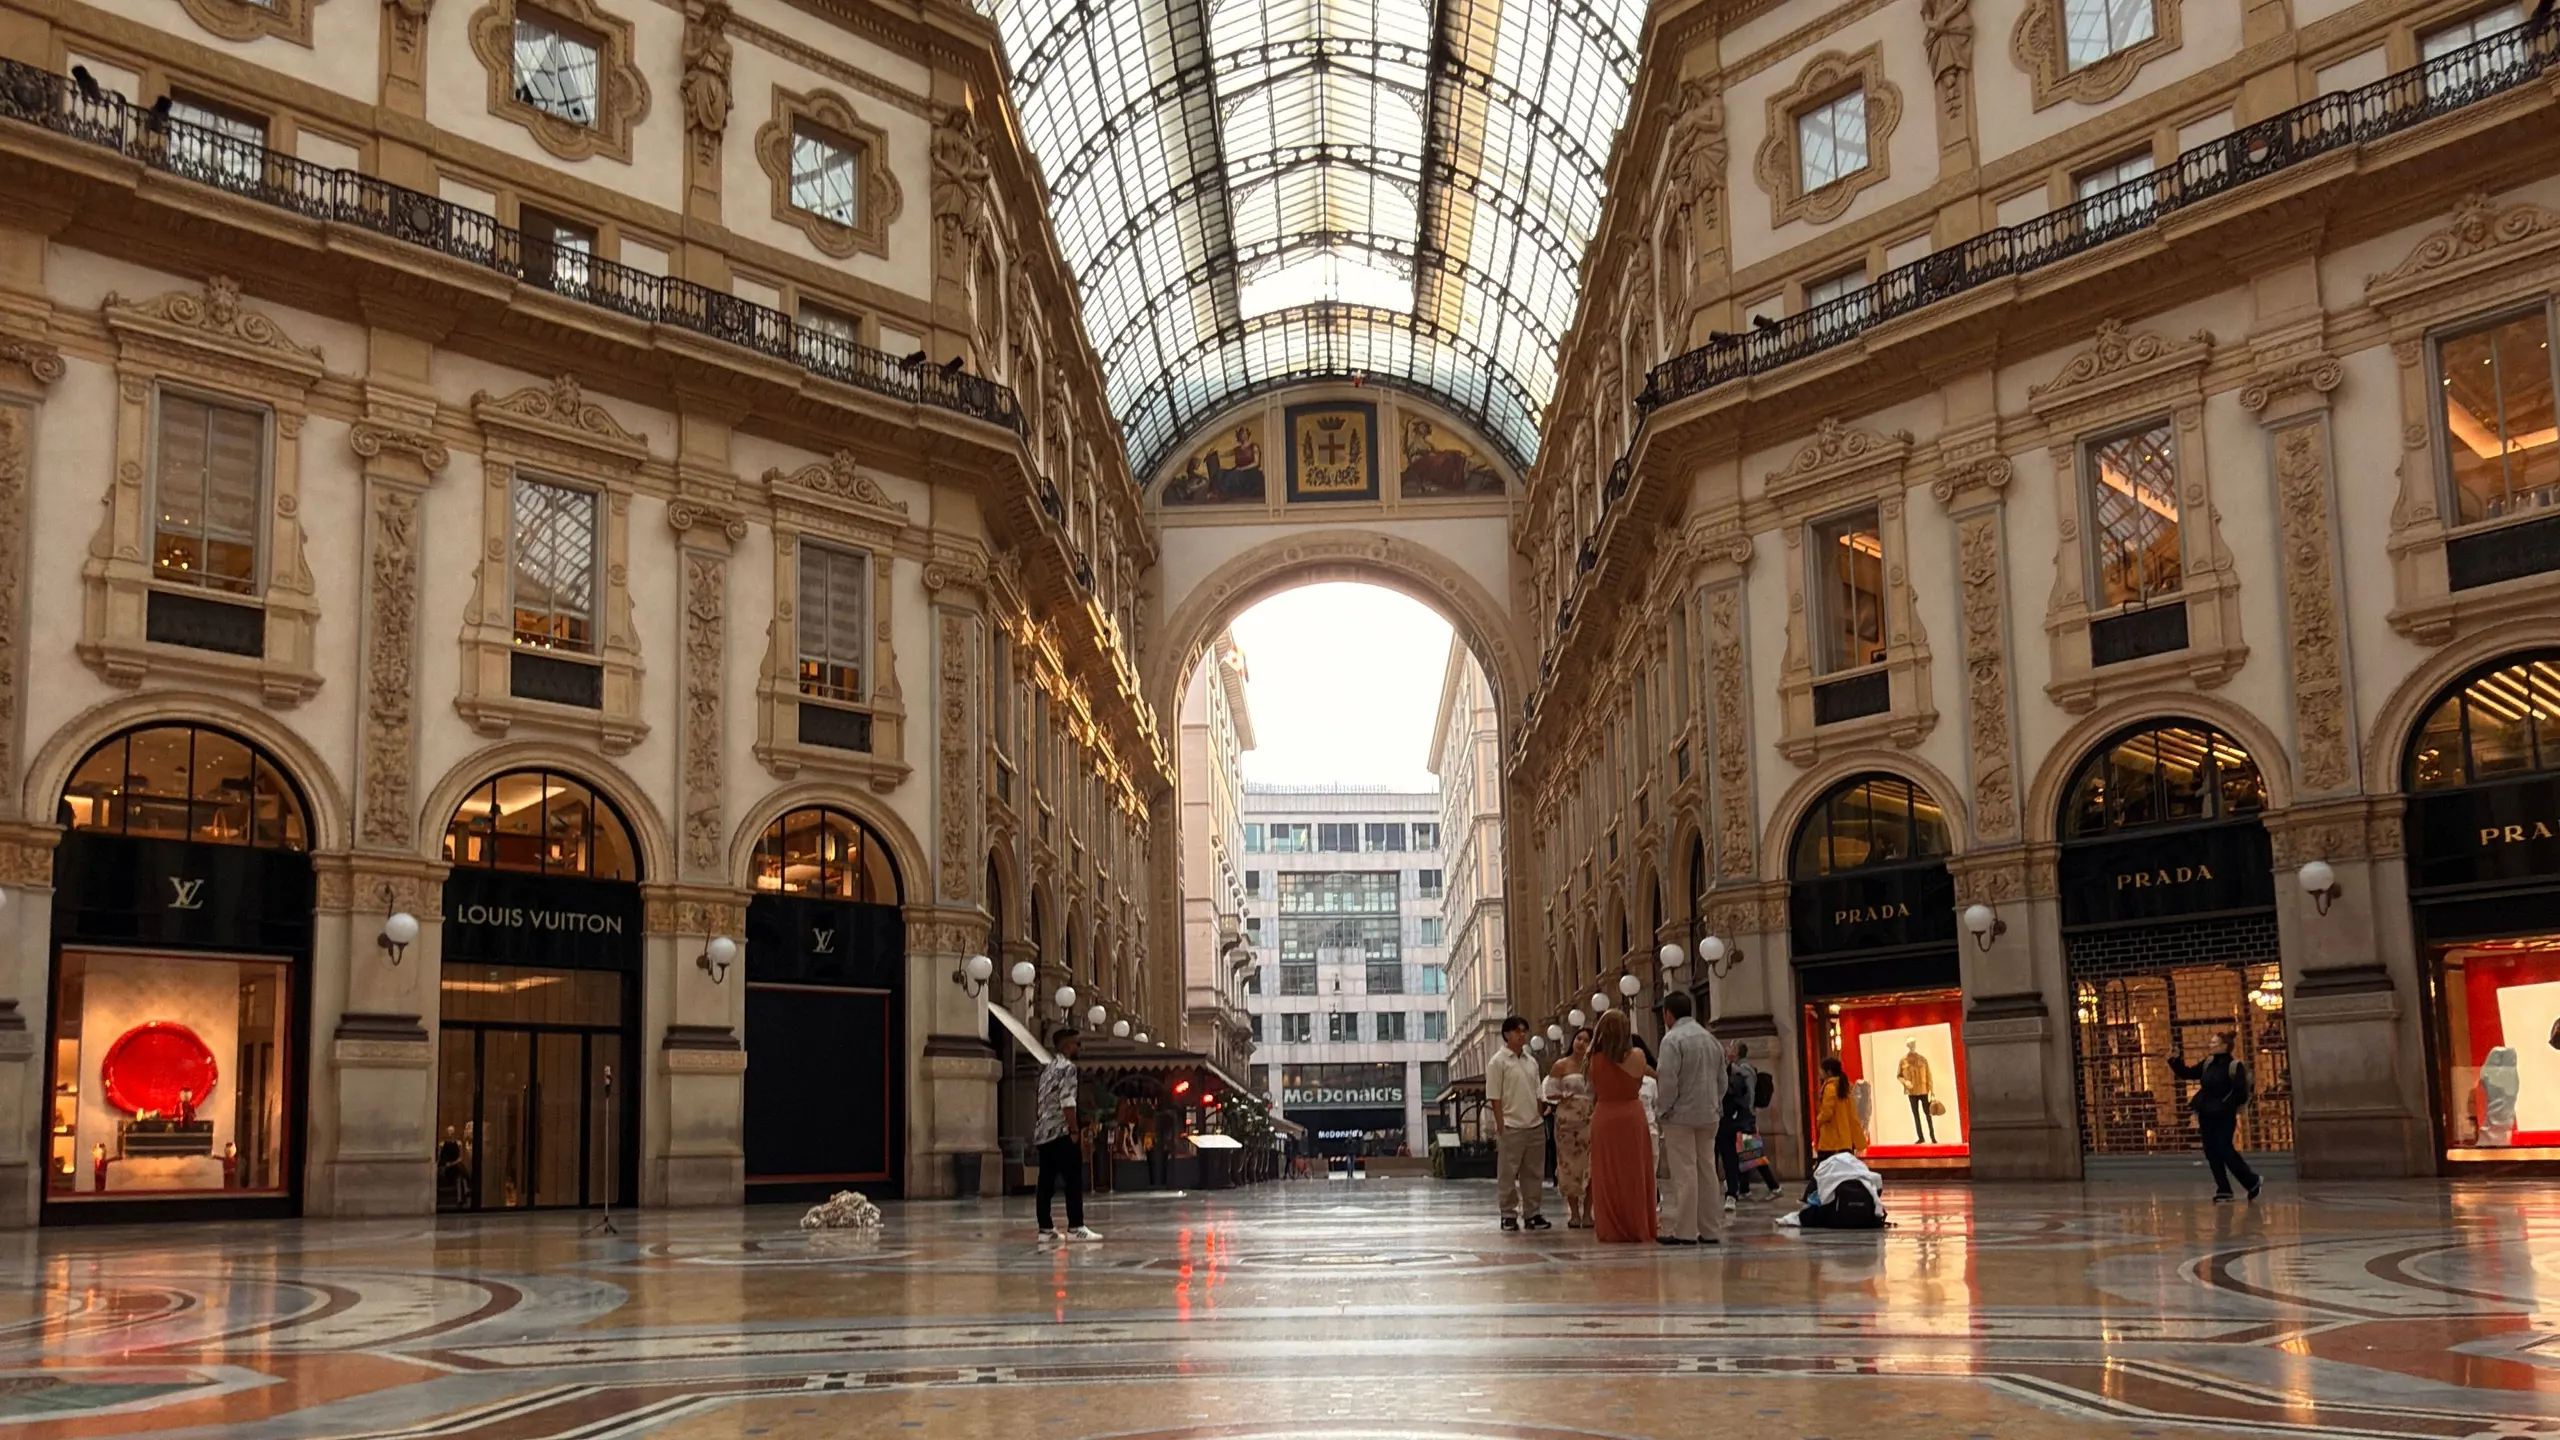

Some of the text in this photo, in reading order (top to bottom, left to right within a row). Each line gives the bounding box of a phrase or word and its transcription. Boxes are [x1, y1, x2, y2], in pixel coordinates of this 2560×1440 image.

[2480, 820, 2560, 846] PRA
[2117, 864, 2213, 890] PRADA
[458, 904, 622, 934] LOUIS VUITTON
[1835, 902, 1910, 925] PRADA
[1284, 1087, 1403, 1103] McDonald's
